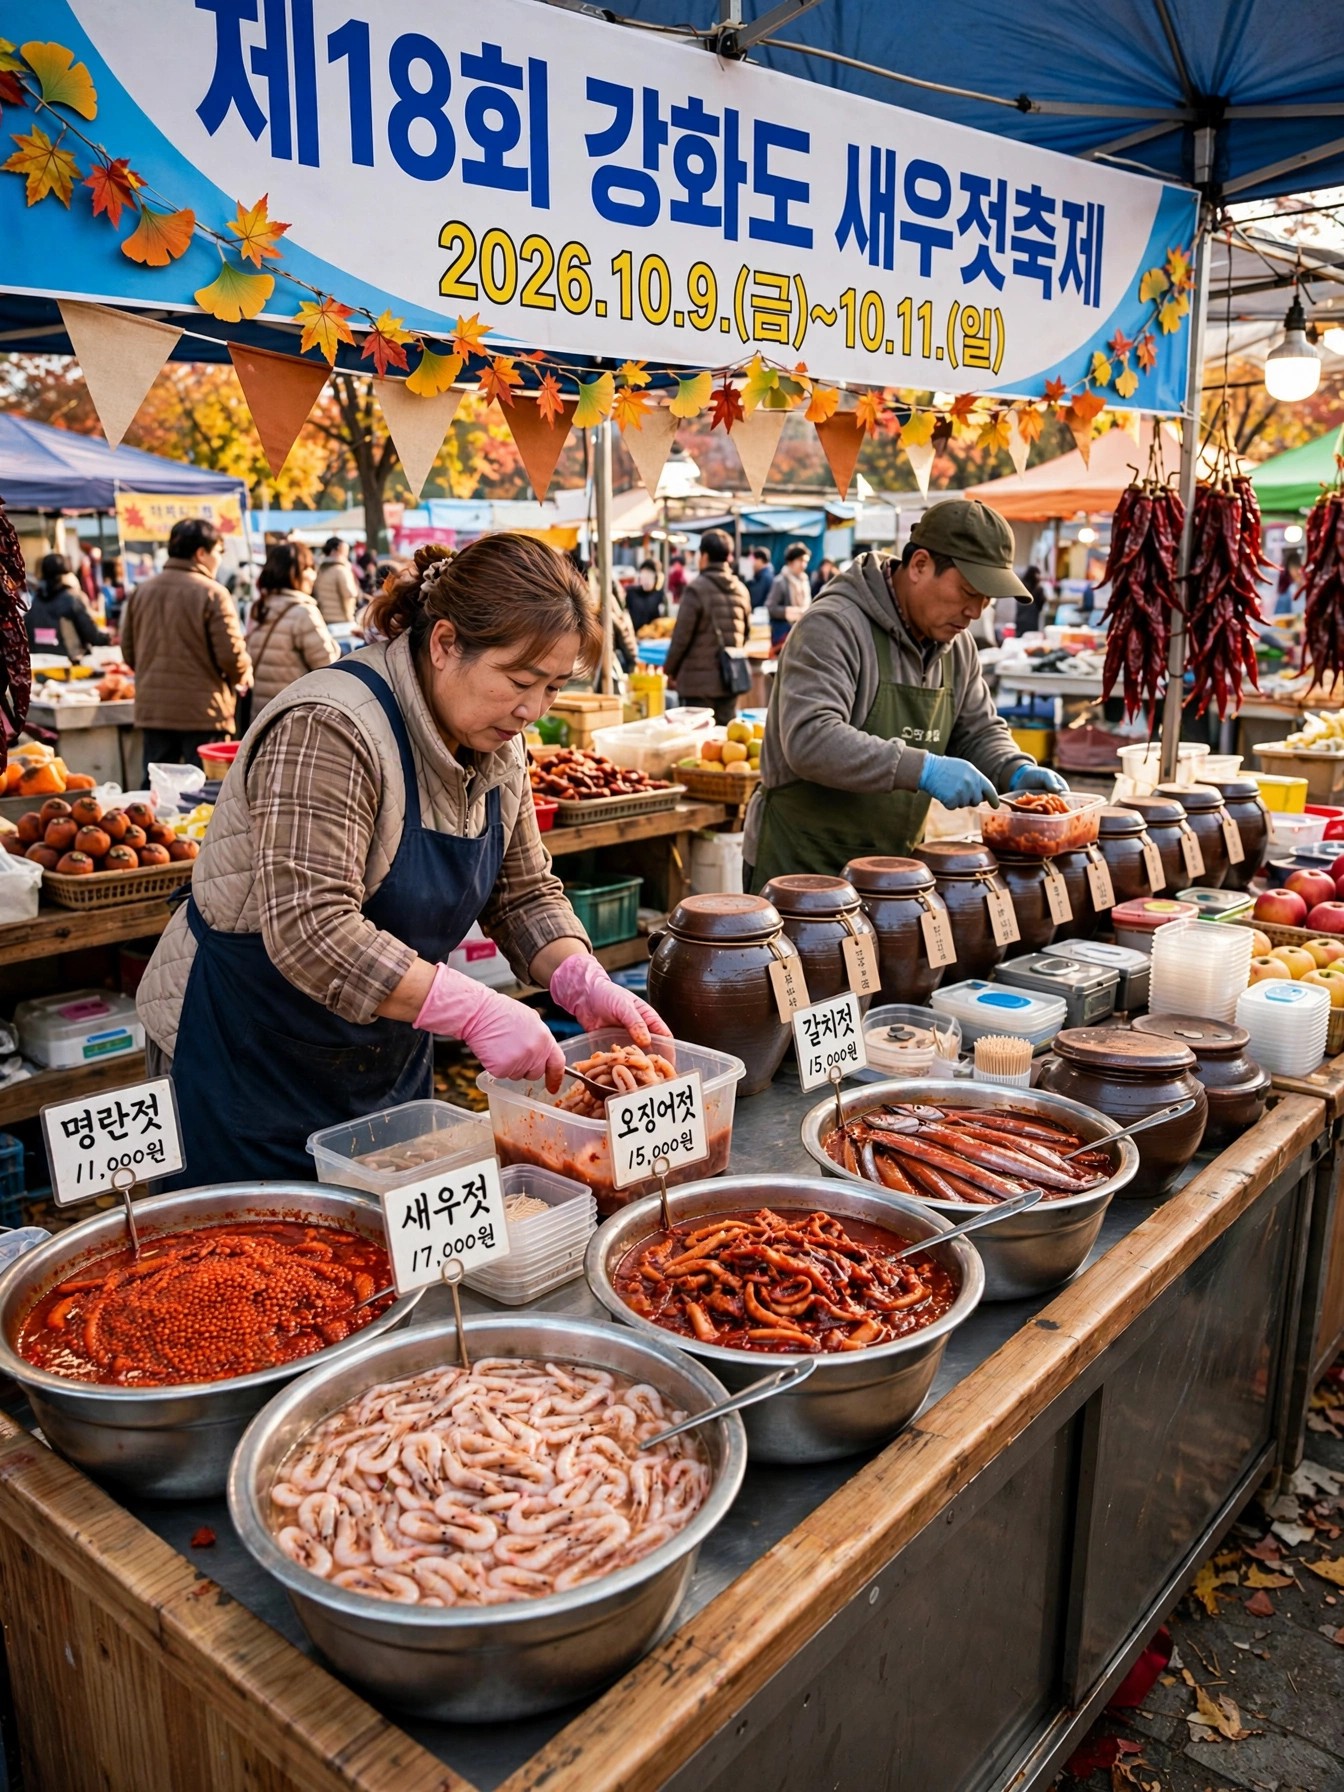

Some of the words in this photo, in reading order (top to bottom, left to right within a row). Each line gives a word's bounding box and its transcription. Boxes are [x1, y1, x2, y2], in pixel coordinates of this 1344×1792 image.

[195, 0, 550, 210] 제18회
[584, 76, 814, 249] 강화도
[834, 142, 1105, 308] 새우젓축제
[437, 219, 1006, 376] 2026.10.9.(금)~10.11.(일)
[802, 1002, 855, 1048] 갈치젓
[809, 1041, 858, 1076] 15,000원
[60, 1092, 162, 1150] 명란젓
[617, 1084, 696, 1139] 오징어젓
[76, 1138, 166, 1184] 11,000원
[628, 1129, 694, 1170] 15,000원
[401, 1173, 491, 1231] 새우젓
[412, 1222, 496, 1272] 17,000원
